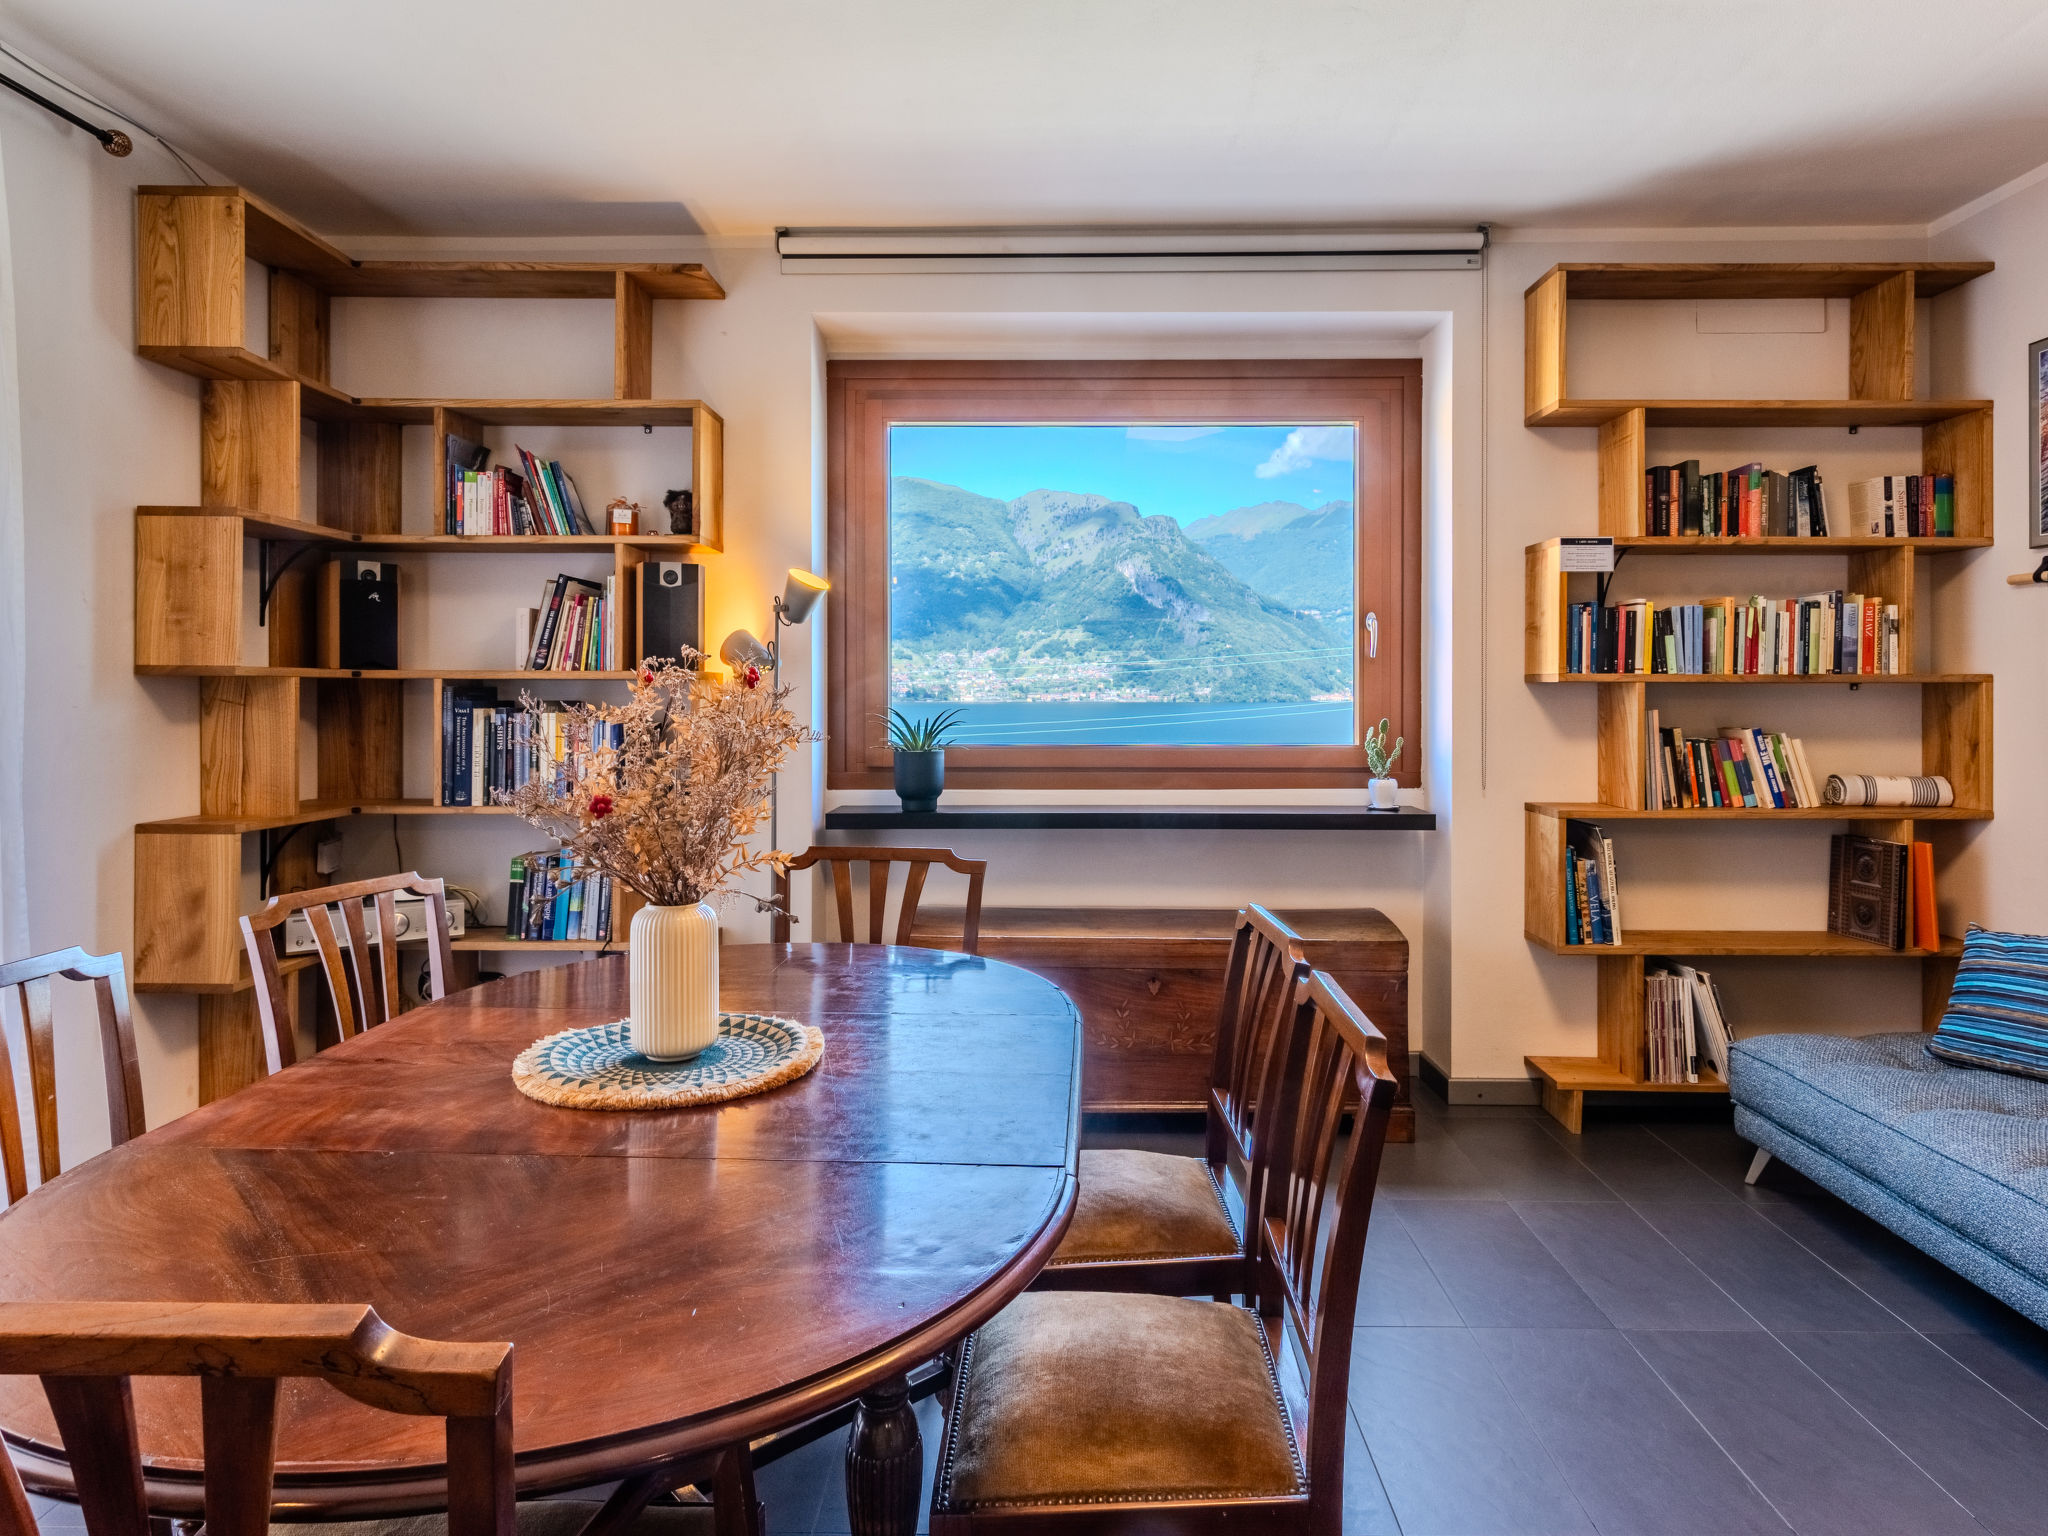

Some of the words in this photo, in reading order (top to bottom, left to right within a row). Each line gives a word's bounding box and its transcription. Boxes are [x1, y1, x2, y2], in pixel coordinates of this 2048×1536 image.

[1896, 490, 1906, 520] Sapiens
[1865, 606, 1873, 637] ZWEIG
[1590, 894, 1600, 923] VELA
